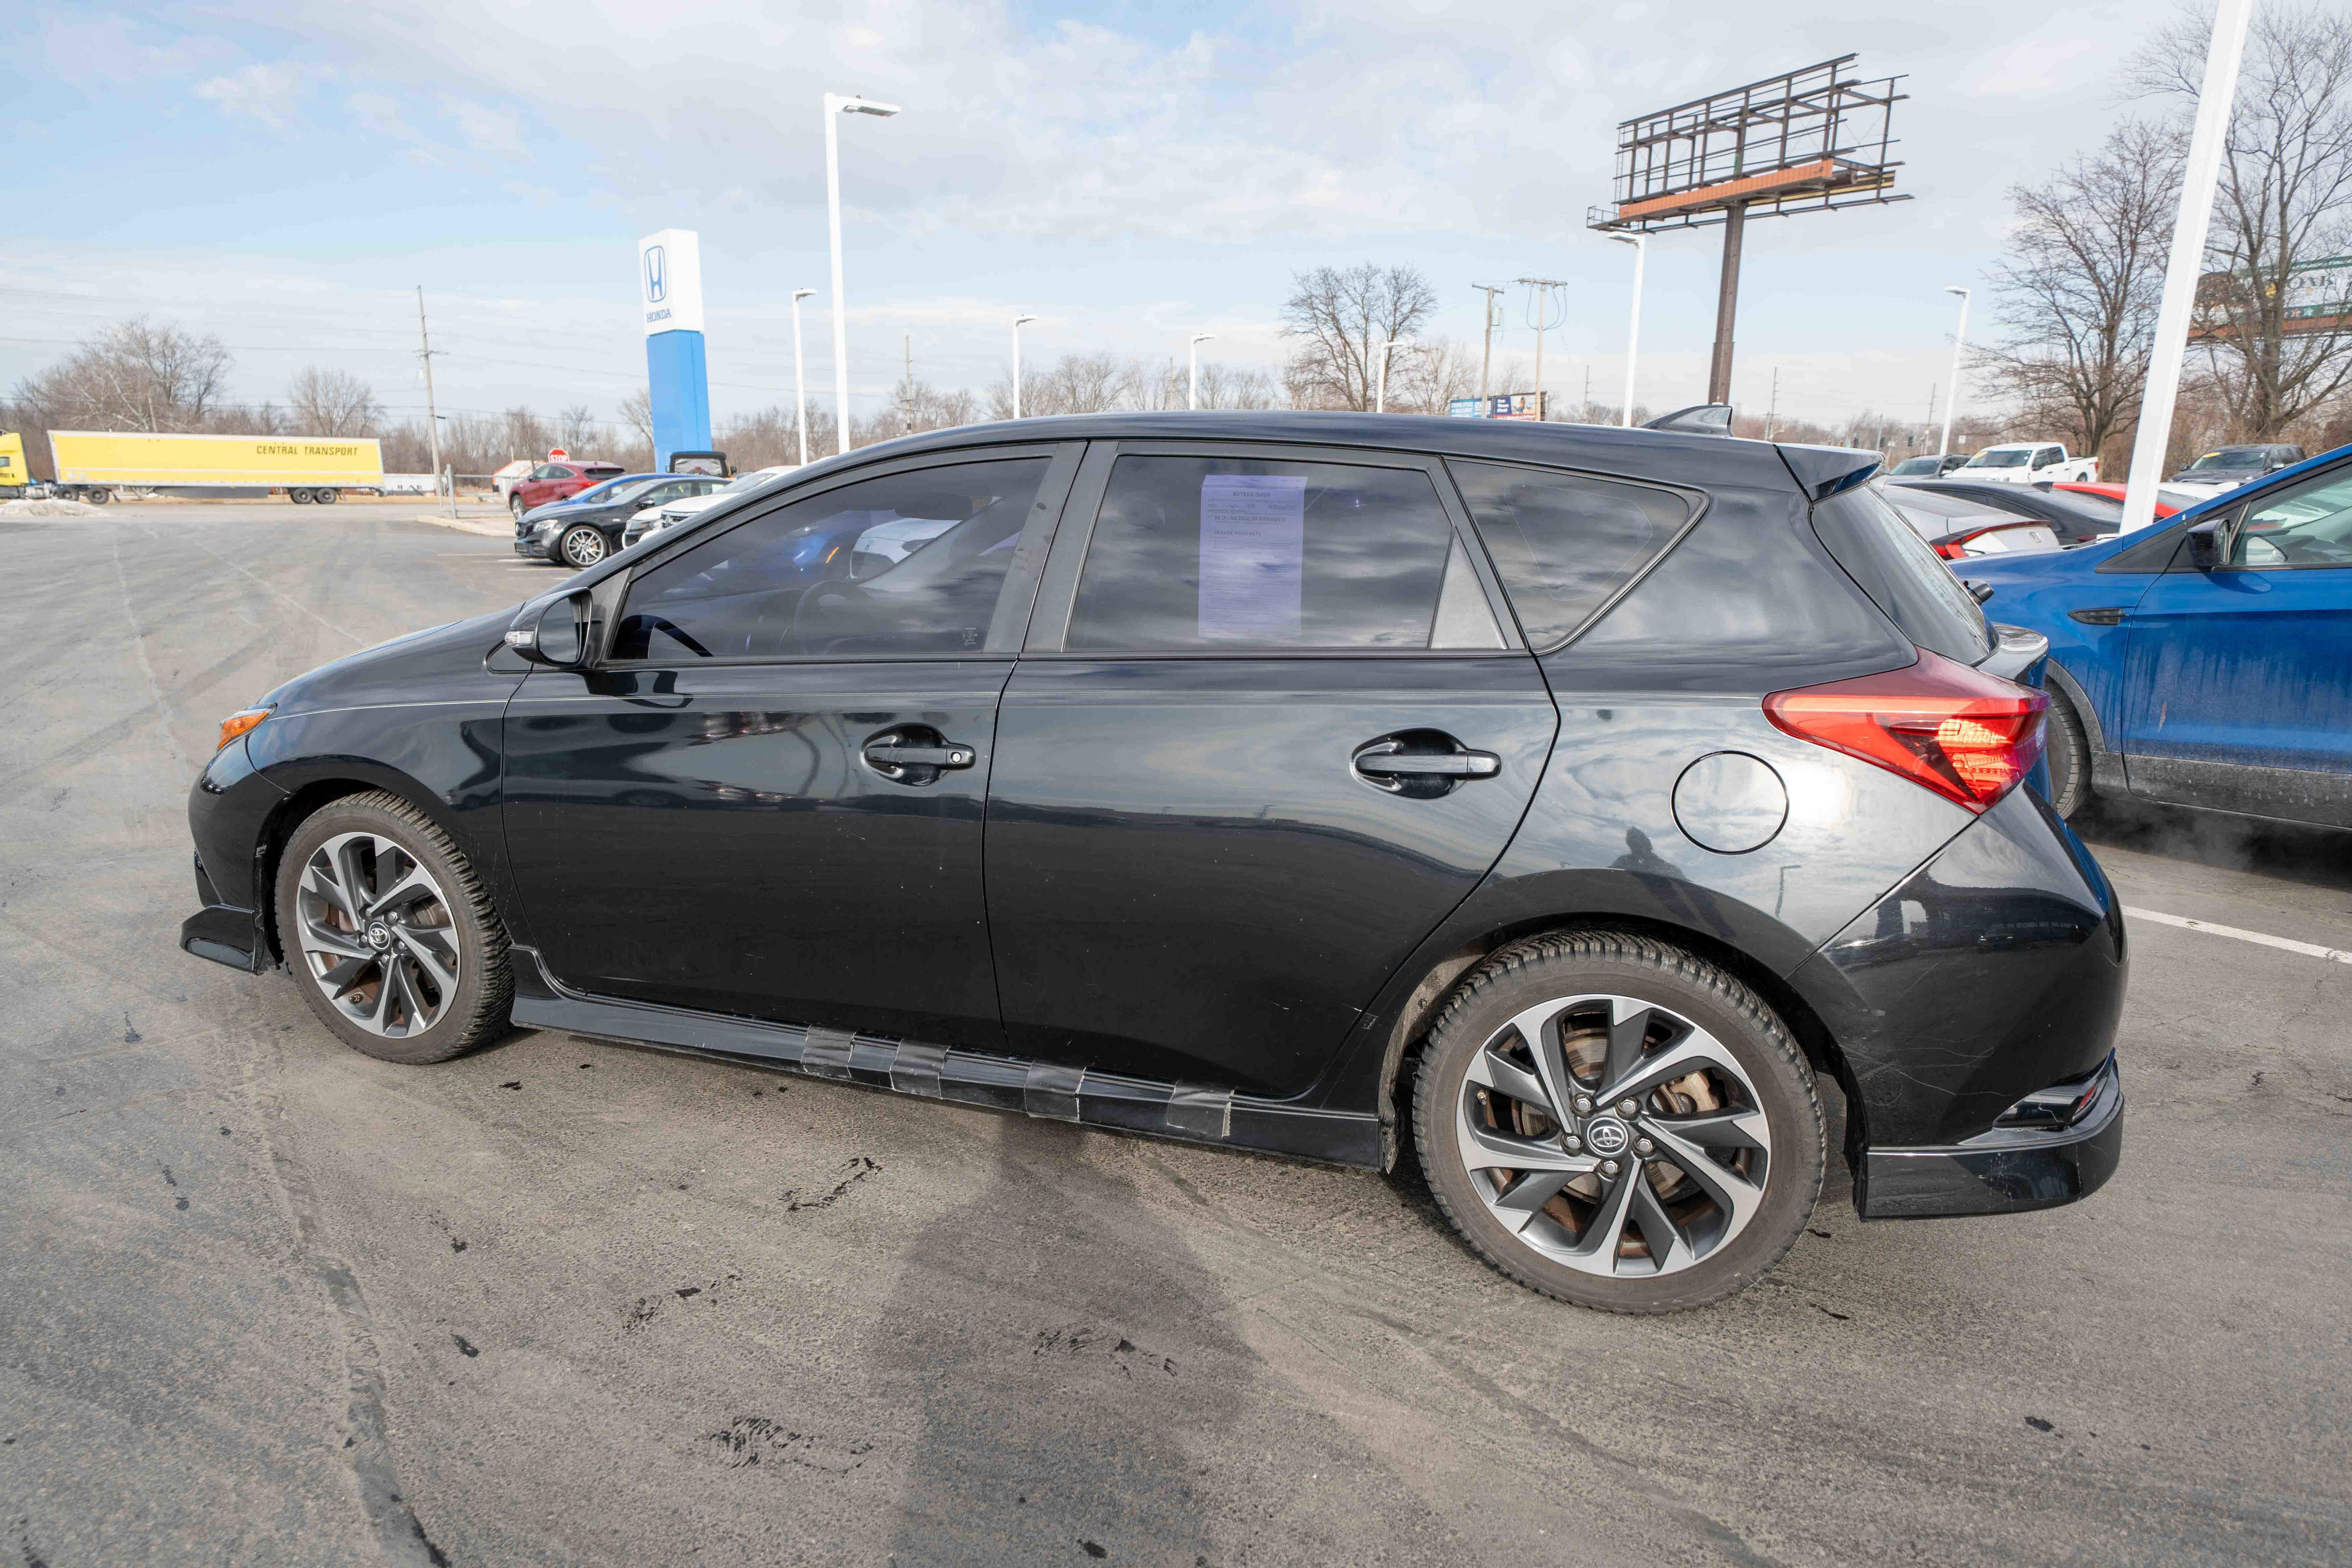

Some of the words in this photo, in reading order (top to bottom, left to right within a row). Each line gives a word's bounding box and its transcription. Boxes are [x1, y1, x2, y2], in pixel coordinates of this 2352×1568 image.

[646, 307, 672, 323] HONDA
[256, 445, 298, 454] CENTRAL
[304, 446, 359, 456] TRANSPORT
[550, 454, 568, 462] STOP
